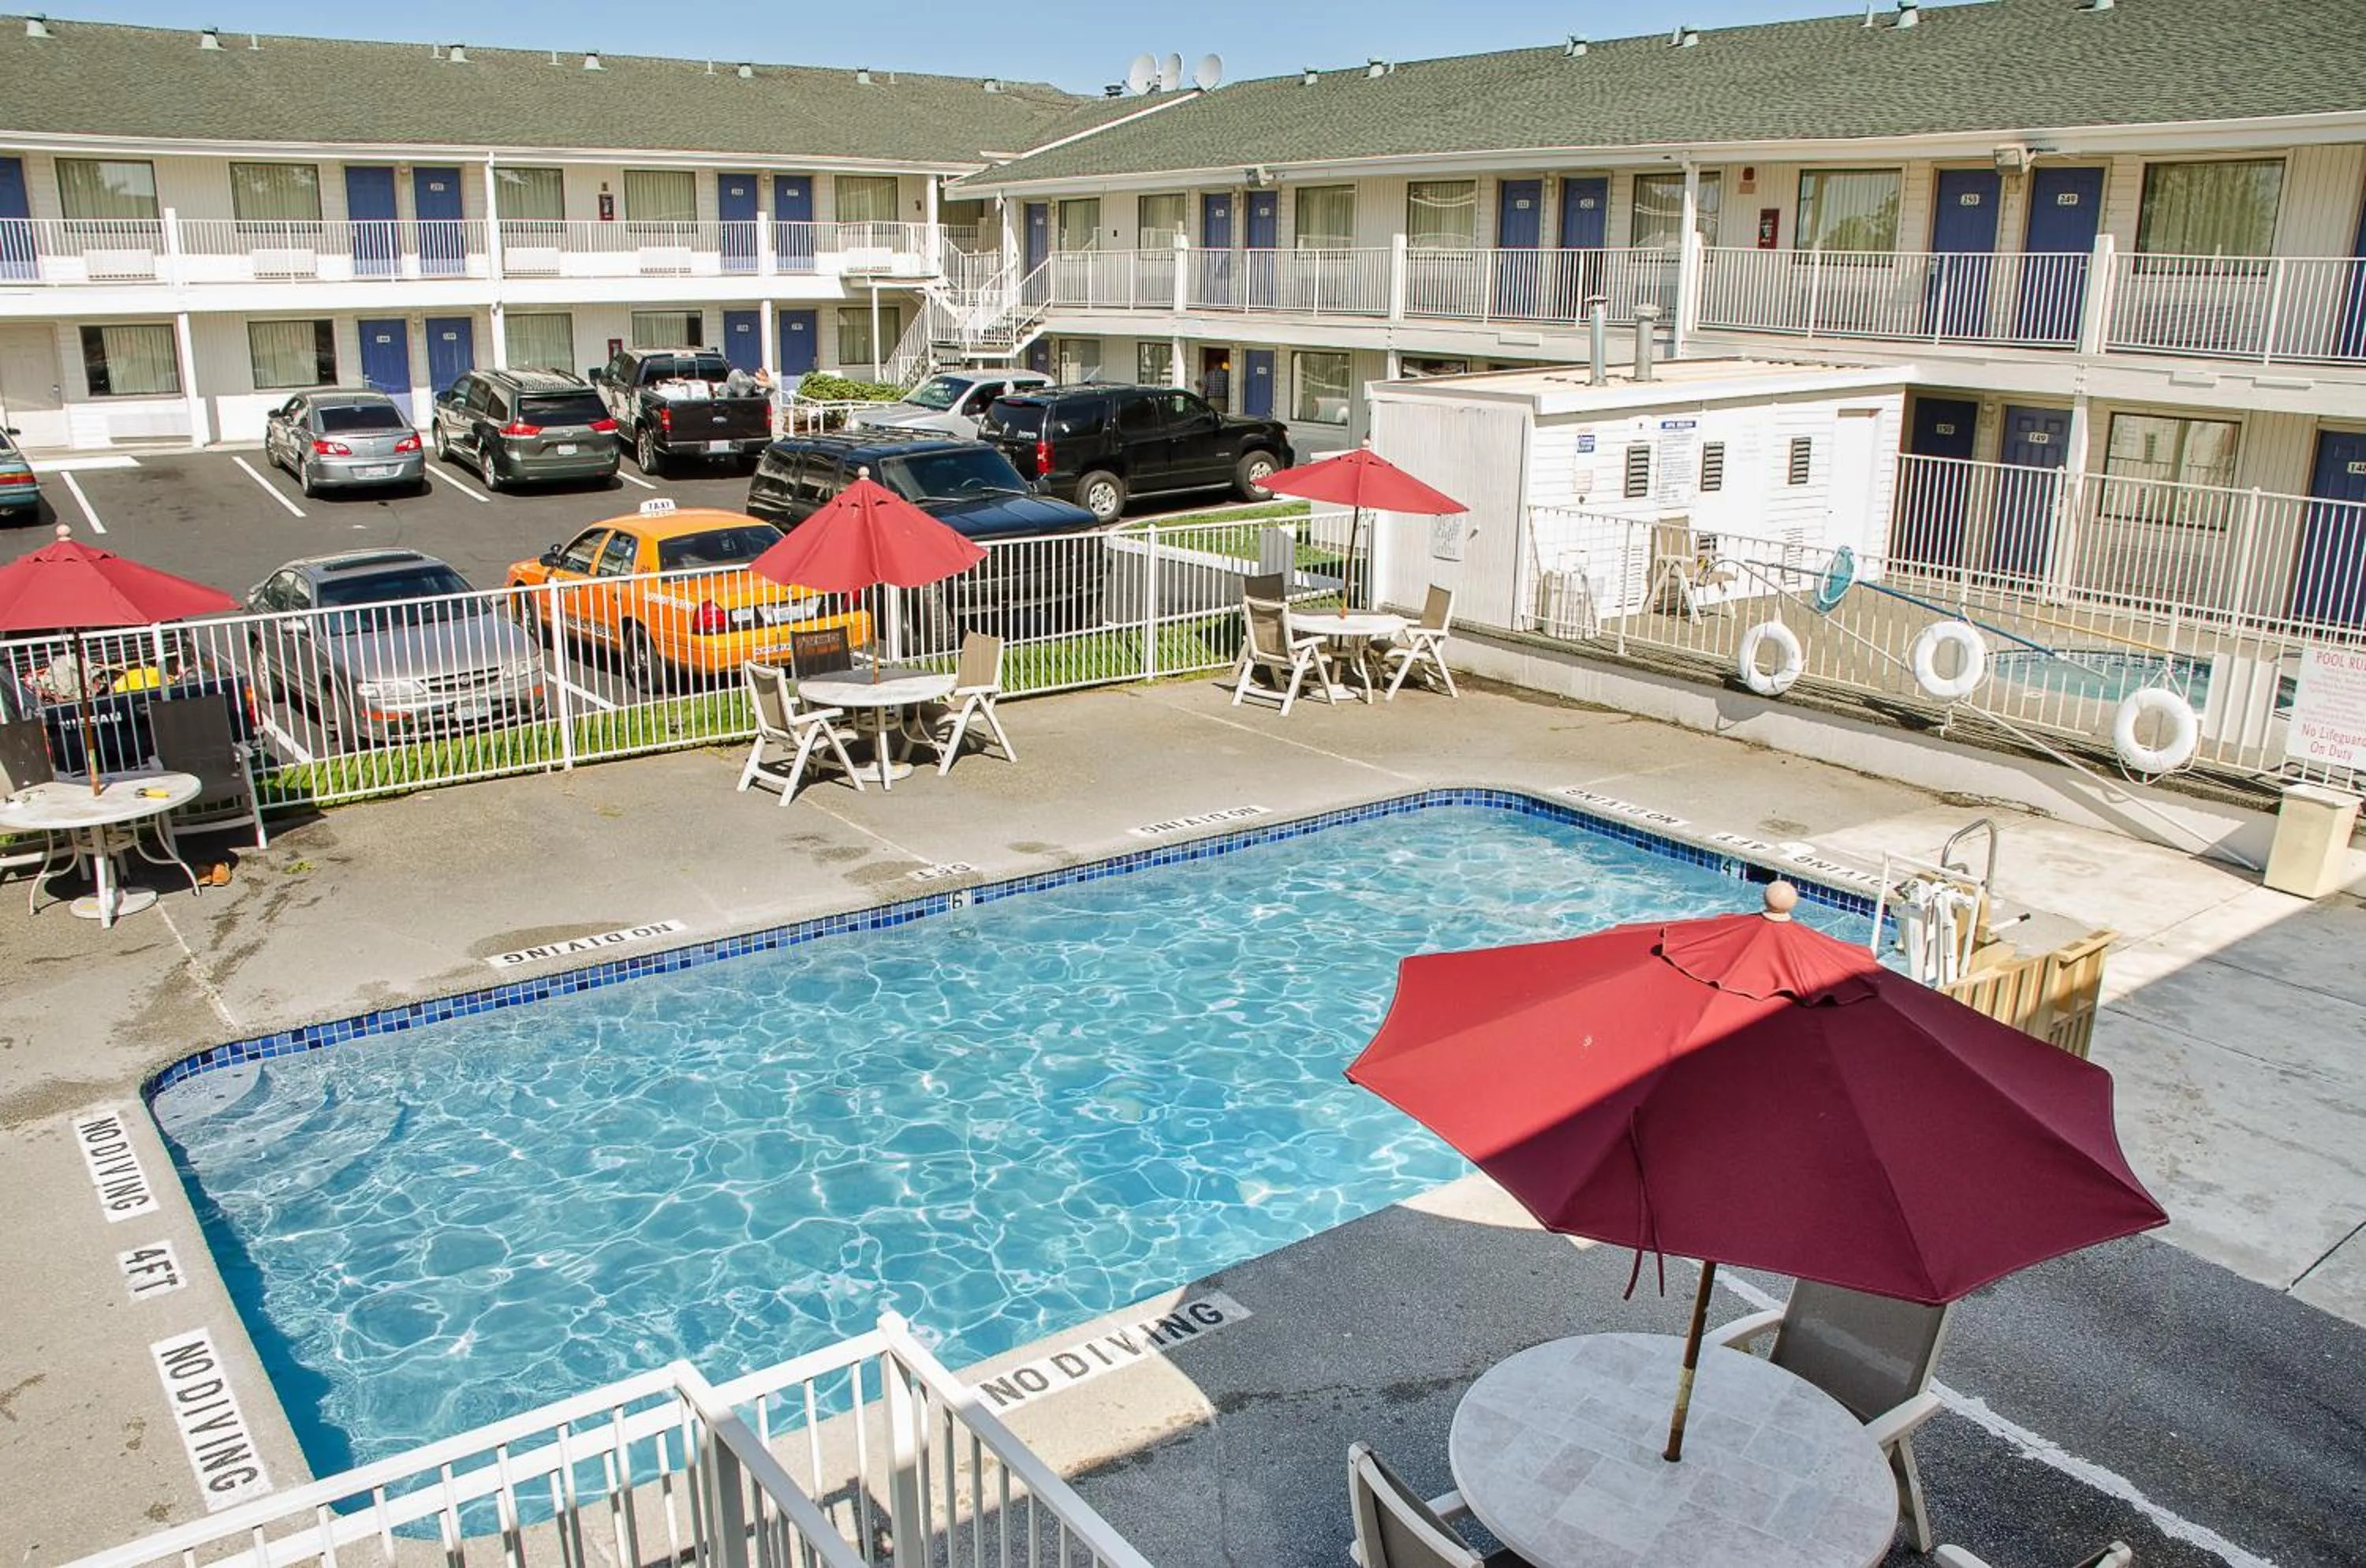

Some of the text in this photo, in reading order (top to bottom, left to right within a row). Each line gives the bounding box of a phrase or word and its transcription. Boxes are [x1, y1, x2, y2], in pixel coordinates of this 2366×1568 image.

[2031, 431, 2047, 441] 149
[2316, 651, 2366, 670] POOL RU
[2301, 722, 2316, 737] No
[2310, 741, 2353, 760] On Duty
[1140, 807, 1260, 834] NO DIVING
[1722, 858, 1732, 875] 4
[952, 889, 963, 909] 6
[503, 924, 673, 964] NO DIVING
[79, 1117, 150, 1210] NO DIVING
[126, 1249, 178, 1293] 4FT
[980, 1302, 1224, 1407] NO DIVING
[161, 1340, 258, 1492] NO DIVING
